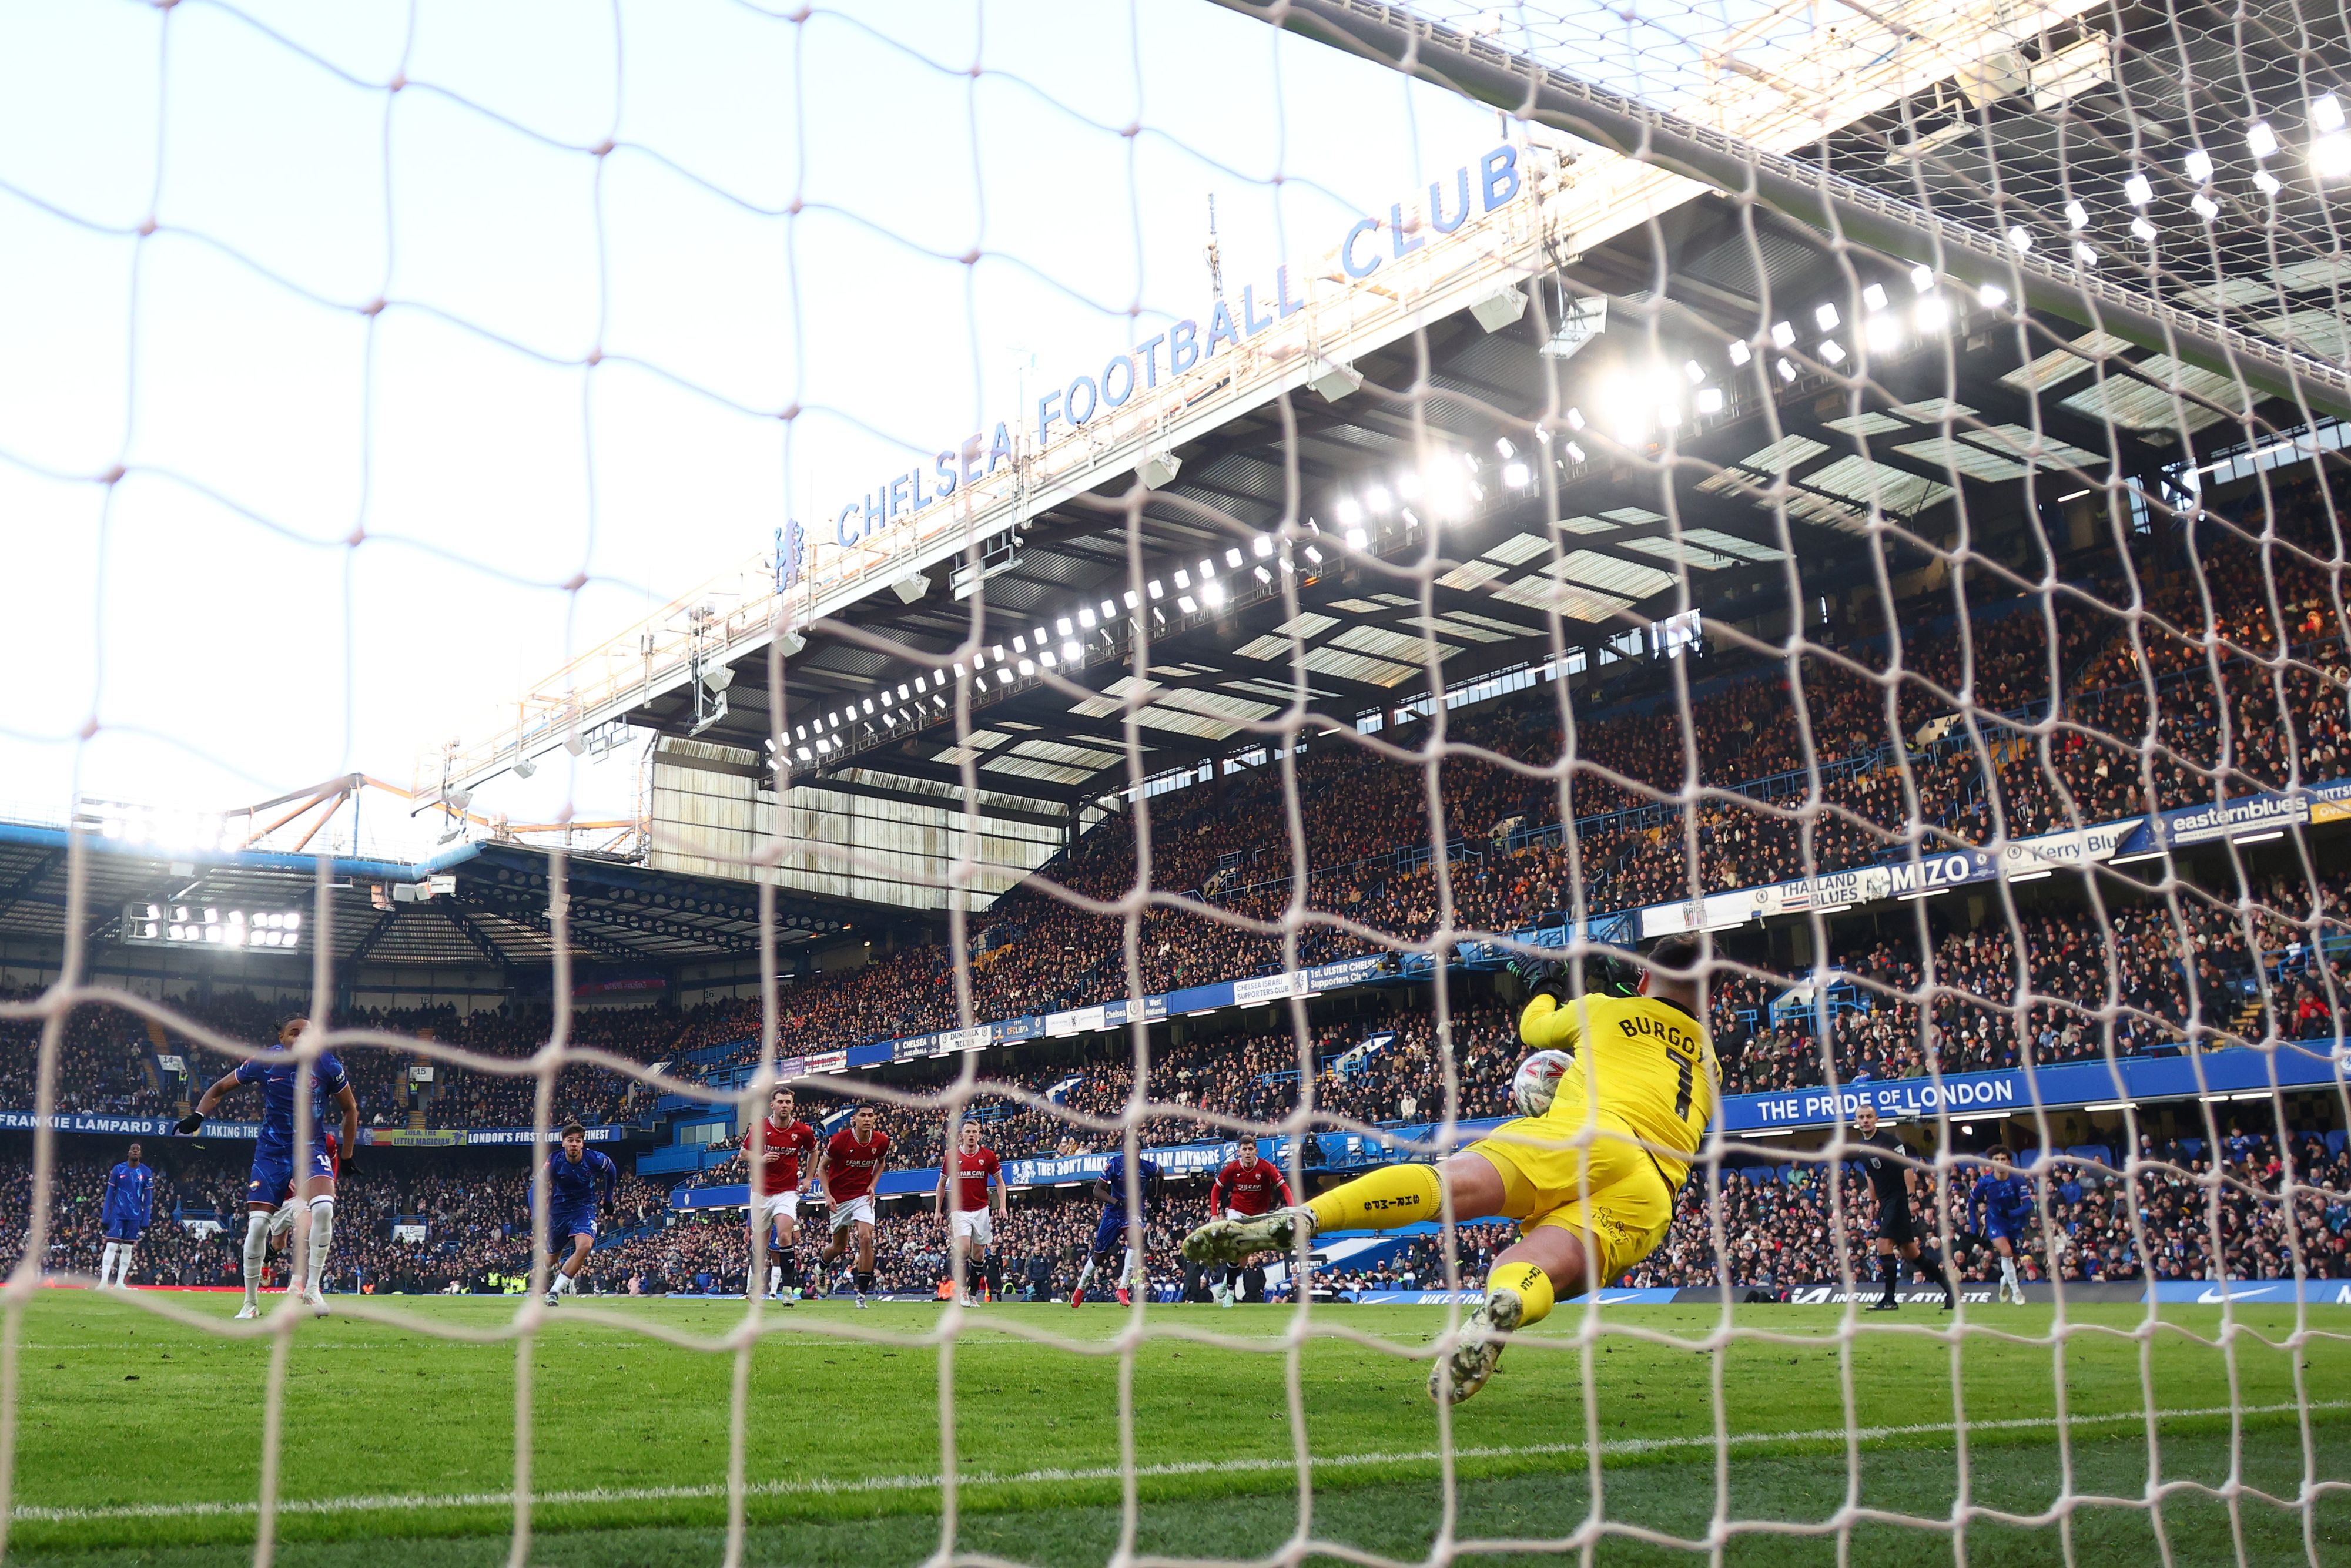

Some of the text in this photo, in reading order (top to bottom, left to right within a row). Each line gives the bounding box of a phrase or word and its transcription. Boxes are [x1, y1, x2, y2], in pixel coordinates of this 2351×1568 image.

[837, 144, 1521, 547] CHELSEA FOOTBALL CLUB
[2317, 785, 2351, 802] PITTS
[2173, 796, 2308, 831] easternblues
[2032, 842, 2080, 862] Kerry
[1891, 855, 1969, 892] MIZO
[1780, 873, 1857, 897] THAILAND
[1811, 887, 1857, 907] BLUES
[1324, 964, 1348, 976] ULSTER
[1237, 978, 1282, 992] CHELSEA ISRAELI
[1311, 976, 1349, 989] Supporters
[1237, 989, 1274, 1000] SUPPORTERS
[1106, 1010, 1126, 1019] Chelsea
[1145, 1007, 1167, 1017] Midlands
[950, 1029, 979, 1040] DUNDALK
[903, 1038, 927, 1049] CHELSEA
[955, 1038, 974, 1048] BLUES
[1757, 1078, 2013, 1121] THE PRIDE OF LONDON
[75, 1118, 152, 1133] LAMPARD
[206, 1125, 259, 1138] TAKING THE
[394, 1137, 414, 1145] LITTLE
[468, 1132, 513, 1144] LONDON'S
[1037, 1162, 1056, 1177] THEY
[1057, 1158, 1082, 1175] DON'T
[1083, 1156, 1108, 1172] MAKE
[1175, 1148, 1220, 1167] ANYMORE
[1364, 1194, 1420, 1211] SHRIMPS
[1417, 1294, 1485, 1304] NIKECOM
[1831, 1292, 1907, 1304] INFINIE
[1908, 1292, 1991, 1304] ATHETE
